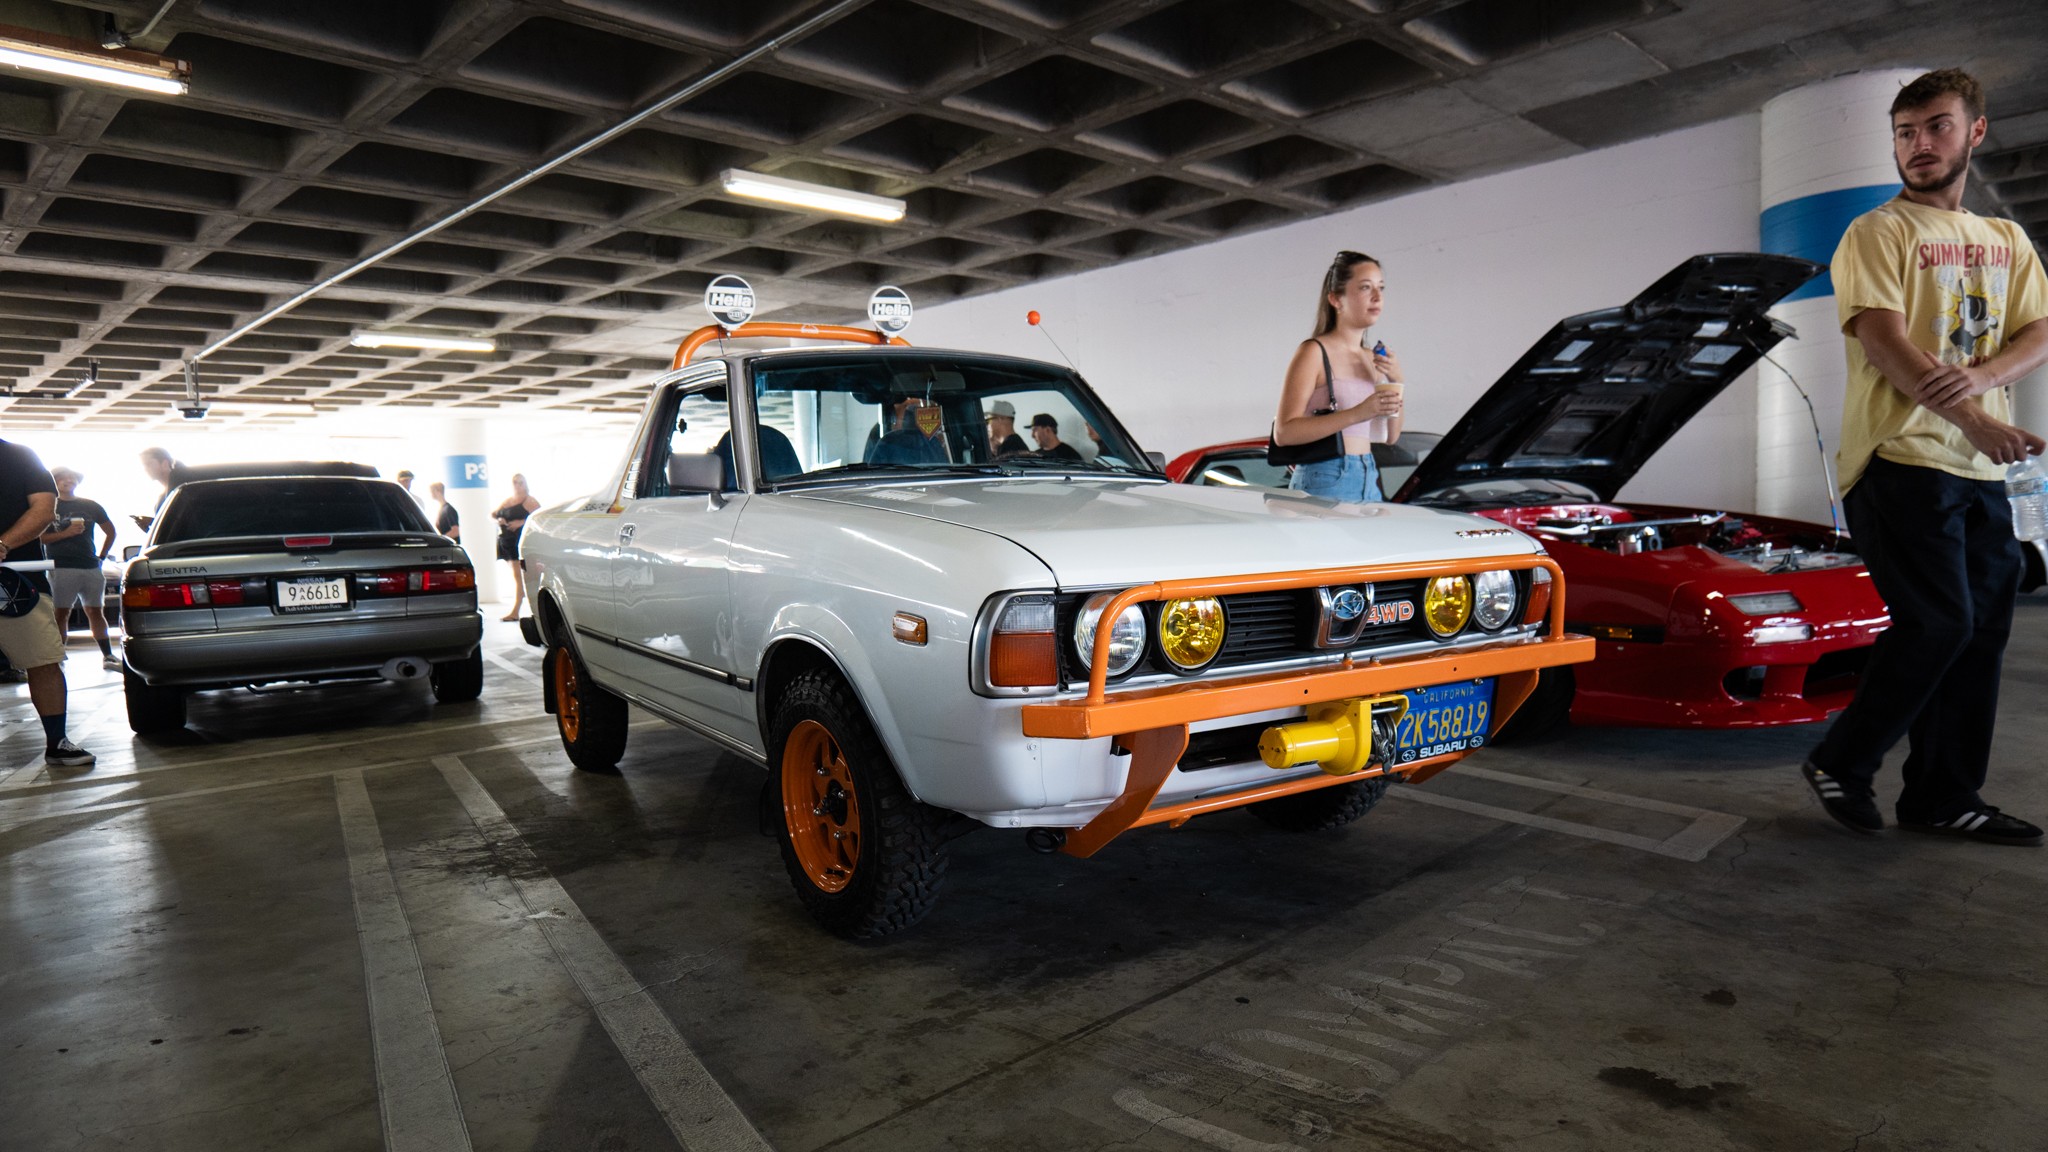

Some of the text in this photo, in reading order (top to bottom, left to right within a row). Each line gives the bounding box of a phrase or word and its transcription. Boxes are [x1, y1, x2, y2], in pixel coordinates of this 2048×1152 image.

[1918, 243, 1985, 270] SUMMER
[711, 293, 752, 307] Hella
[874, 303, 910, 316] Hella
[464, 462, 488, 480] P3
[155, 566, 207, 576] SENTRA
[297, 577, 326, 586] NISSAN
[1367, 600, 1415, 625] 4WD
[1423, 686, 1475, 704] CALIFORNIA
[1400, 701, 1488, 748] 2K58819
[1419, 740, 1467, 758] SUBARU
